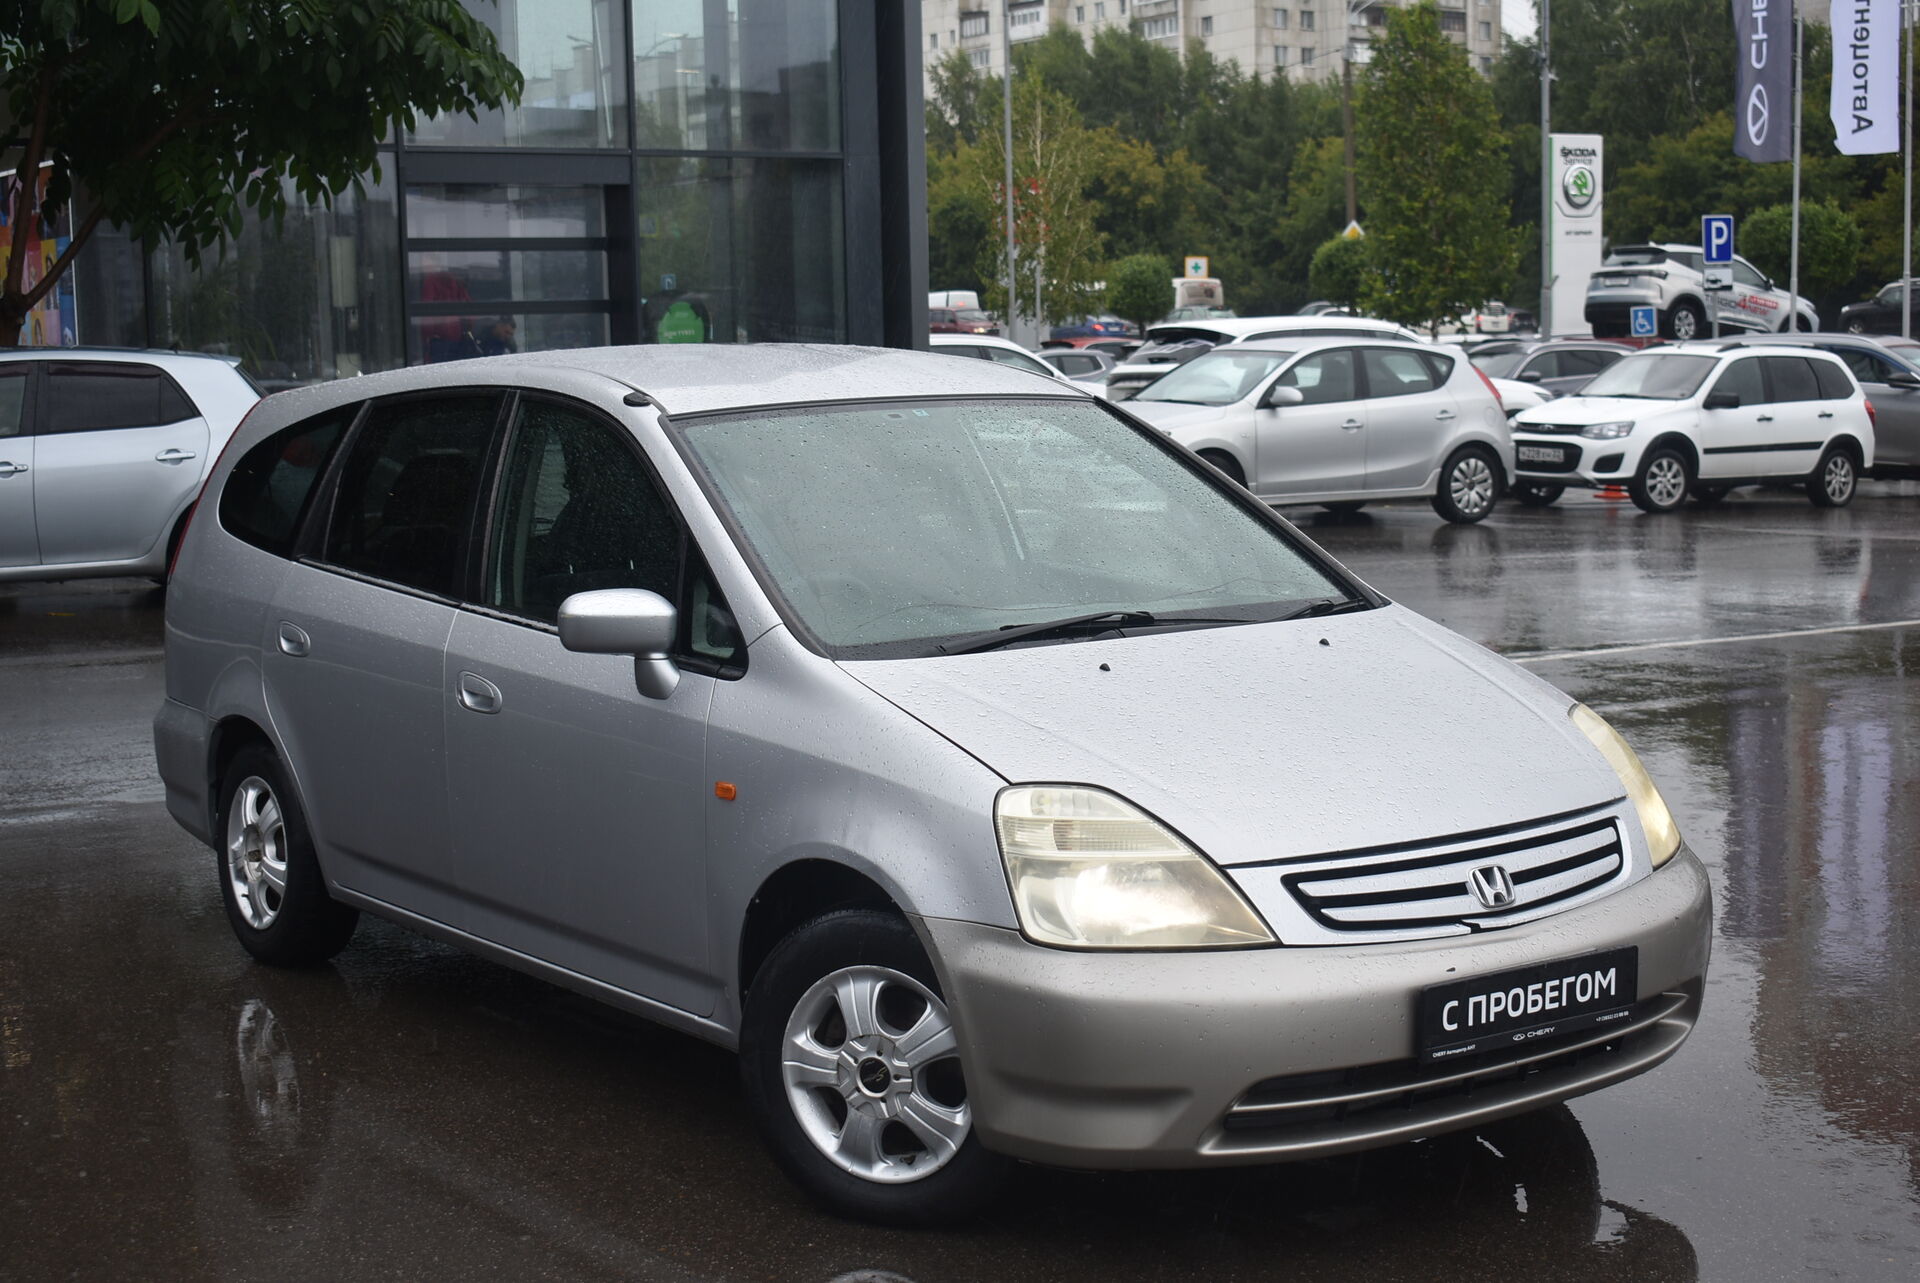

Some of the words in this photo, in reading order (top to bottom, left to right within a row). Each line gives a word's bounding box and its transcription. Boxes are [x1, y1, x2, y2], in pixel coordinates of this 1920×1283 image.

[1711, 221, 1728, 259] P
[1442, 1000, 1459, 1031] С
[1467, 968, 1616, 1027] ПРОБЕГОМ
[1527, 1026, 1555, 1038] CHERY
